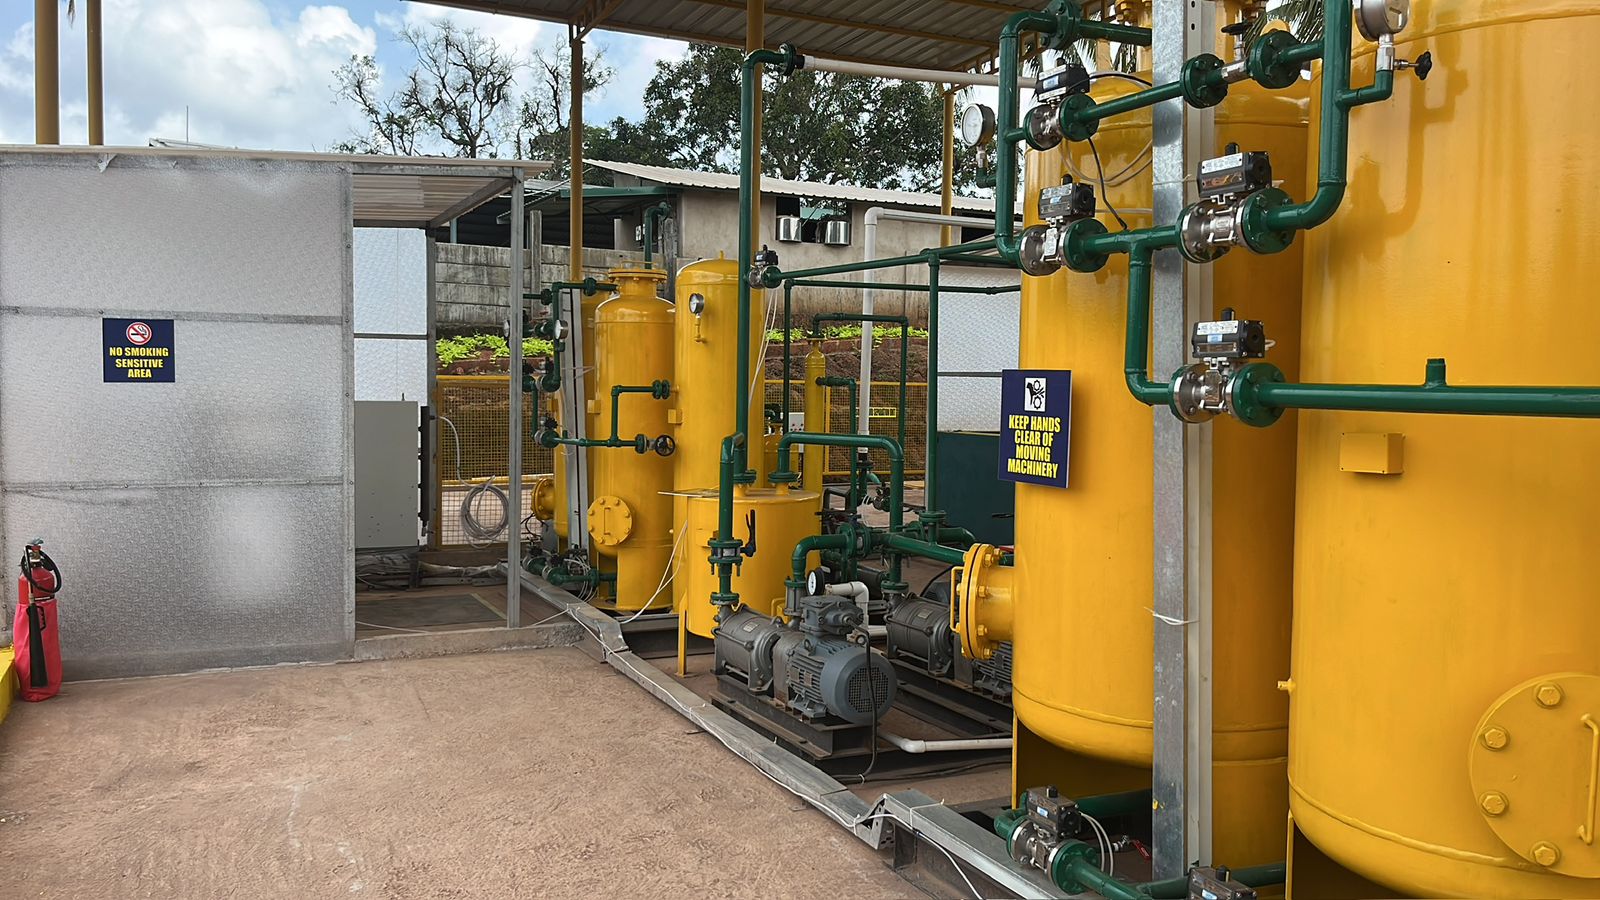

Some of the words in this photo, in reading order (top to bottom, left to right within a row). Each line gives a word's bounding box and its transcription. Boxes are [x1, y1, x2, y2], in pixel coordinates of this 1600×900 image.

[109, 347, 122, 356] NO
[124, 348, 168, 356] SMOKING
[116, 358, 164, 368] SENSITIVE
[128, 369, 152, 378] AREA
[1008, 414, 1029, 430] KEEP
[1030, 416, 1060, 432] HANDS
[1014, 430, 1040, 446] CLEAR
[1042, 432, 1054, 446] OF
[1016, 444, 1050, 462] MOVING
[1008, 458, 1058, 478] MACHINERY
